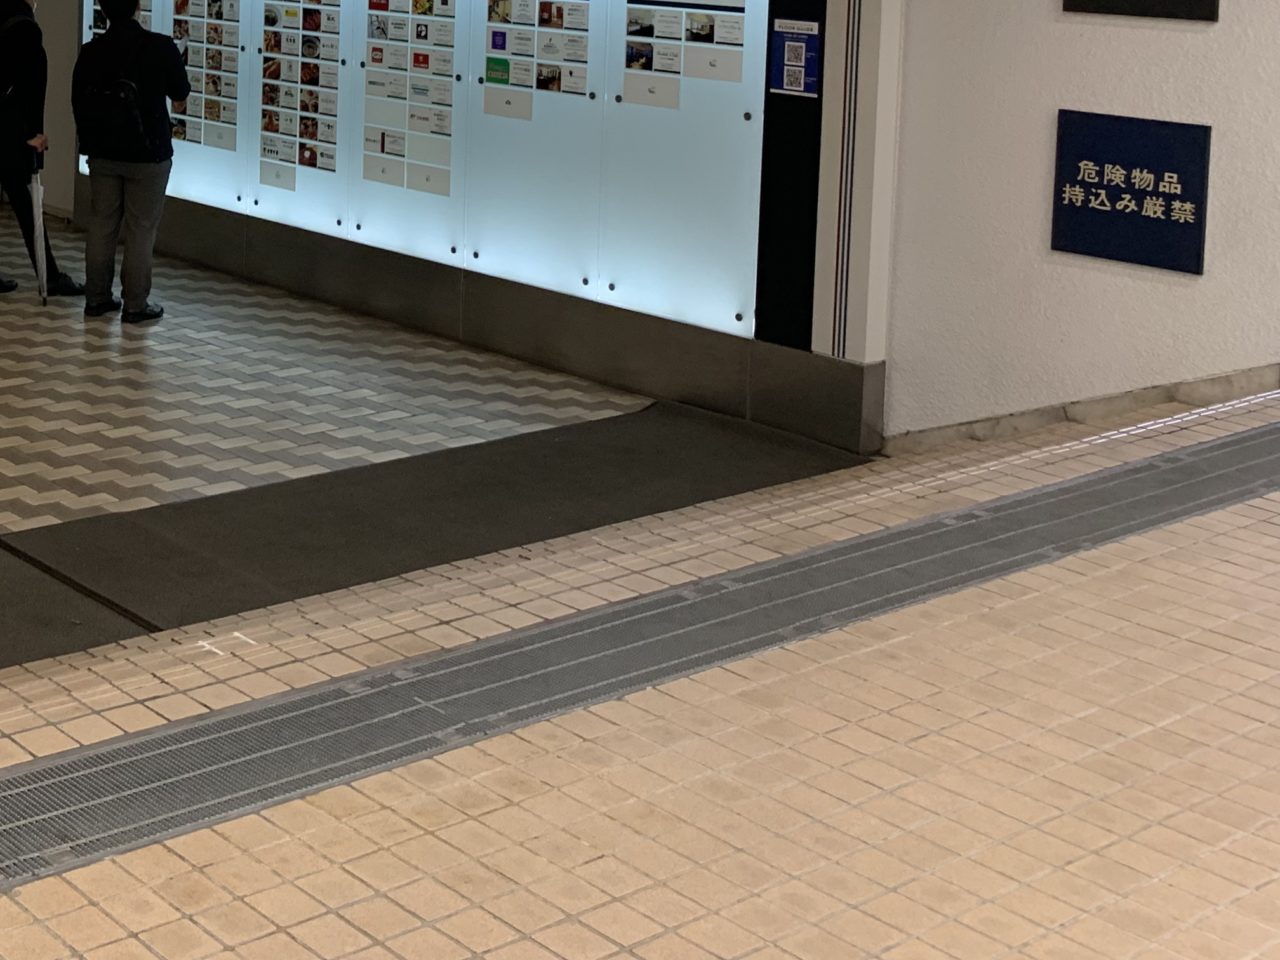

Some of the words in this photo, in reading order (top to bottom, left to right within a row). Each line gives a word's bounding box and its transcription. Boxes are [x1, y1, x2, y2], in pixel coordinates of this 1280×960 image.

[1077, 160, 1182, 195] 危険物品
[1062, 183, 1196, 223] 持込み厳禁
